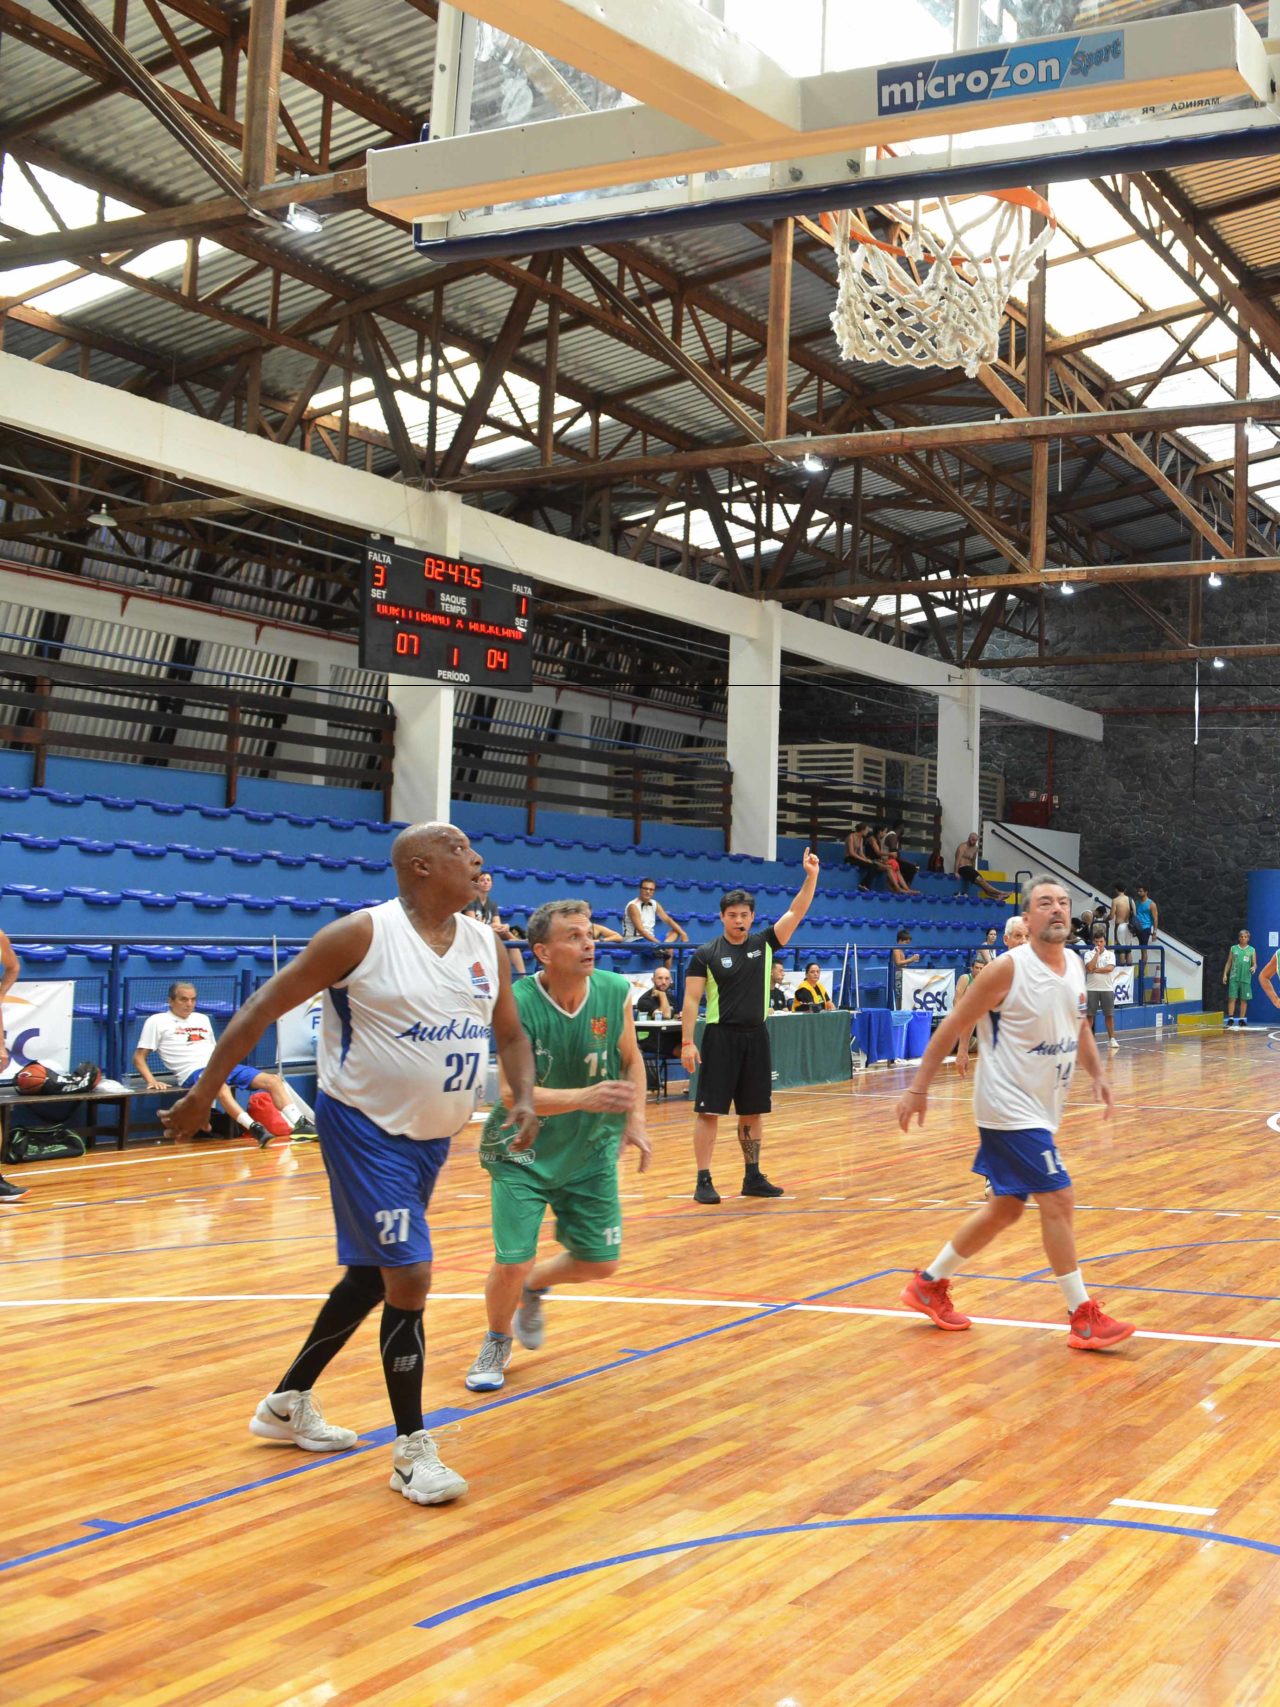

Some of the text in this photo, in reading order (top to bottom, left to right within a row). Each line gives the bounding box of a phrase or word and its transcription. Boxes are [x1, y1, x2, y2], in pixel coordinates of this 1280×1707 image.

[881, 39, 1122, 107] microzon Sport
[368, 551, 392, 565] FALTA
[374, 564, 386, 588] 3
[371, 588, 387, 600] SET
[440, 592, 467, 606] SAQUE
[512, 583, 532, 596] FALTA
[440, 602, 467, 616] TEMPO
[521, 597, 527, 616] 1
[515, 616, 528, 628] SET
[396, 632, 419, 656] 07
[453, 647, 459, 667] 1
[487, 648, 508, 670] 04
[913, 987, 948, 1013] Sesc
[1114, 984, 1131, 1002] esc
[442, 1052, 481, 1093] 27
[374, 1208, 411, 1246] 27
[603, 1226, 622, 1247] 13
